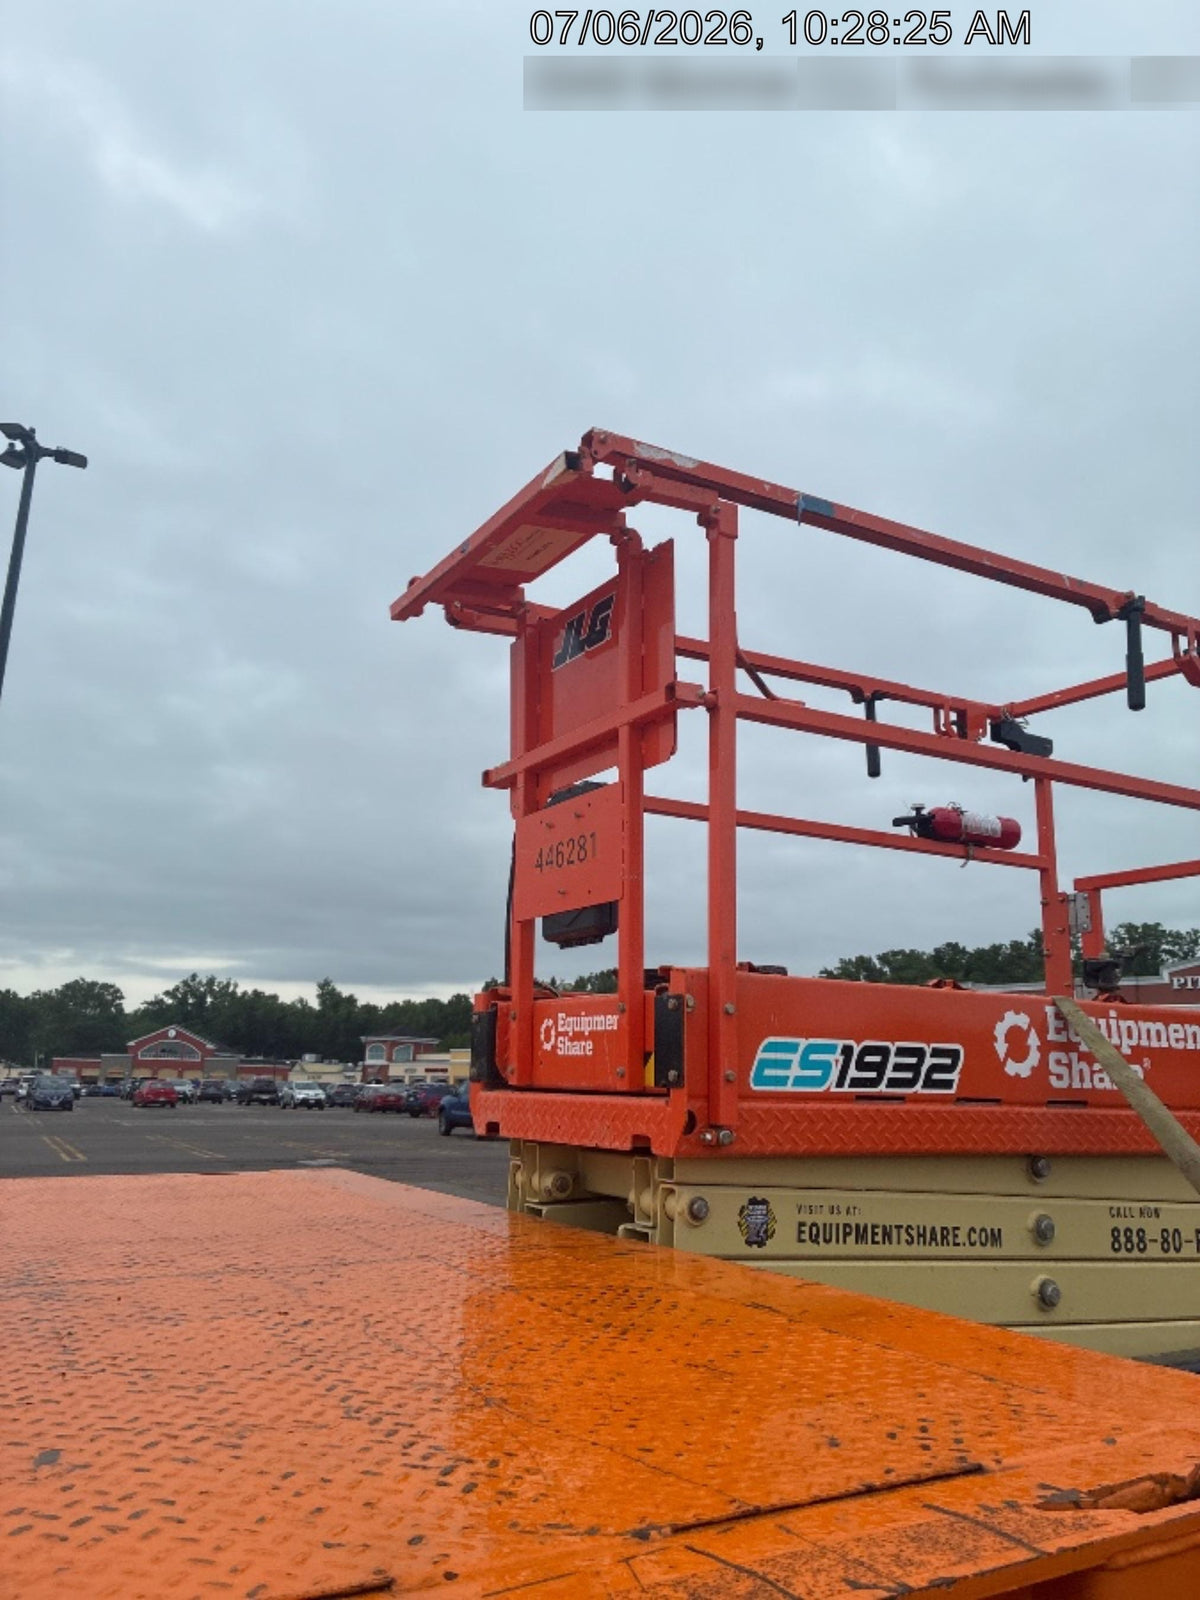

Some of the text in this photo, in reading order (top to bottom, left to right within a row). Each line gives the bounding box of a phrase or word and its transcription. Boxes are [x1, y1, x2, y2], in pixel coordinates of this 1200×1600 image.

[551, 592, 615, 672] JLG
[534, 831, 596, 873] 446281
[557, 1036, 593, 1055] Share
[750, 1036, 964, 1094] ES1932
[796, 1204, 824, 1216] VISIT
[829, 1204, 841, 1215] US
[1109, 1206, 1135, 1219] CALL
[796, 1221, 1003, 1248] EQUIPMENTSHARE.COM
